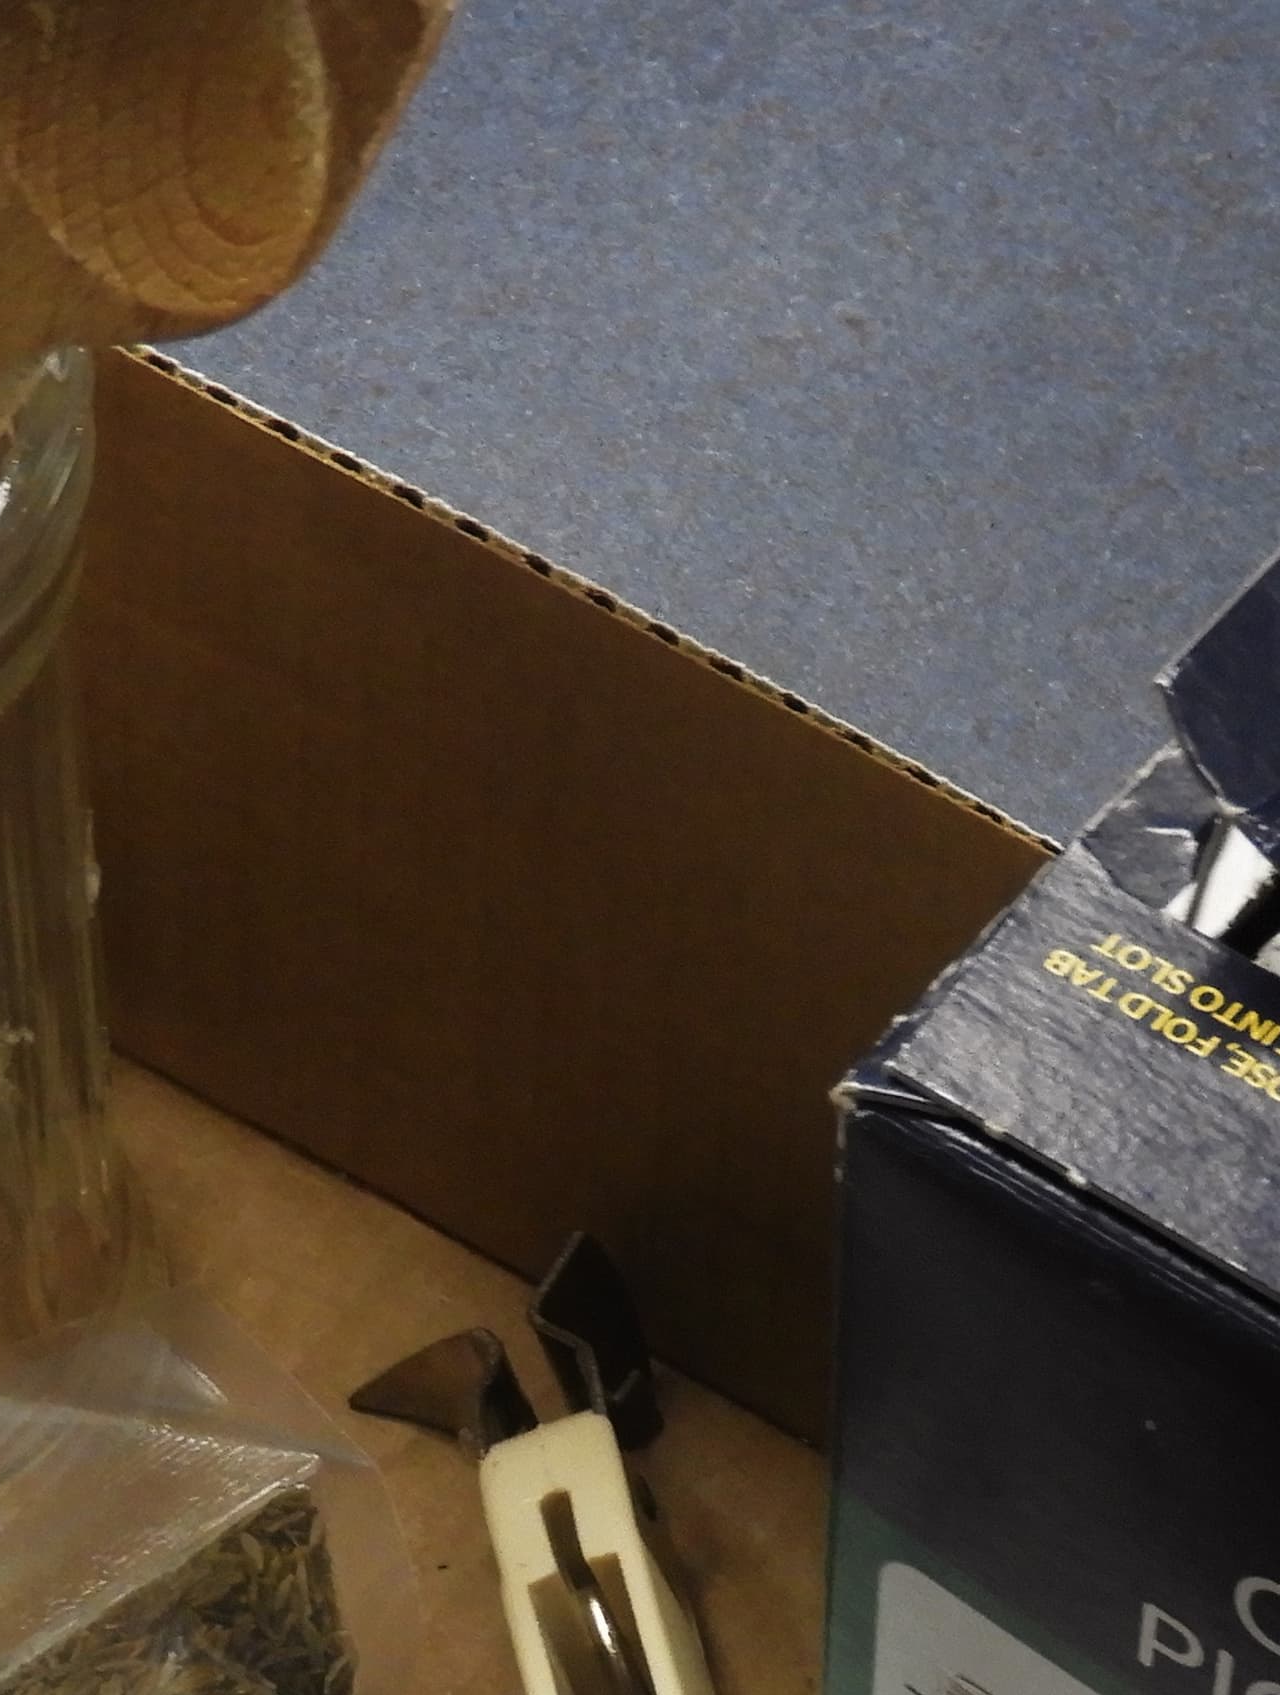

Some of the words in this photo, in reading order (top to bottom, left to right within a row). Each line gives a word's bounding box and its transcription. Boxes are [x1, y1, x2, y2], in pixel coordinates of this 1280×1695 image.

[1041, 942, 1122, 1006] TAB
[1088, 922, 1195, 1003] SLOT
[1113, 981, 1222, 1063] FOLD
